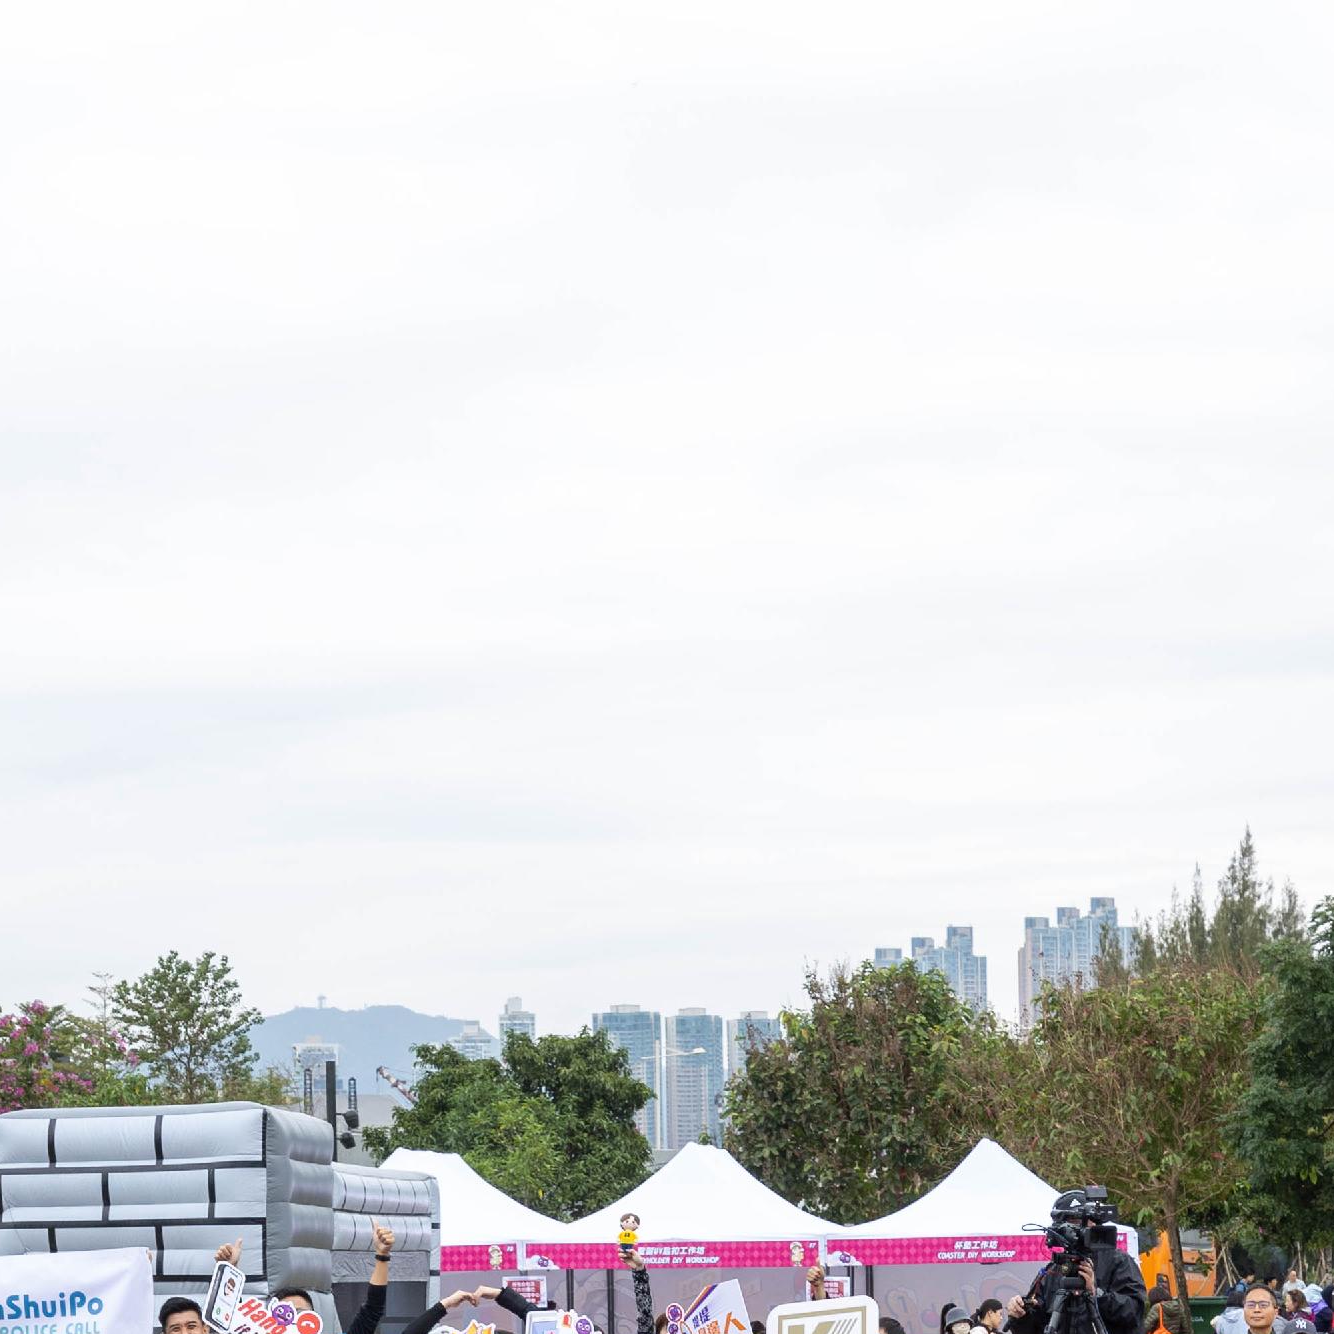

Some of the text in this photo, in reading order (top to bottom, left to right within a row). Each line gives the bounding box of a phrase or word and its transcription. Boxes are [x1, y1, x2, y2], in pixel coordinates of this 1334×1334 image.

[938, 1250, 1016, 1260] COASTER DIY WORKSHOP
[672, 1256, 684, 1264] DIY
[685, 1256, 720, 1264] WORKSHOP
